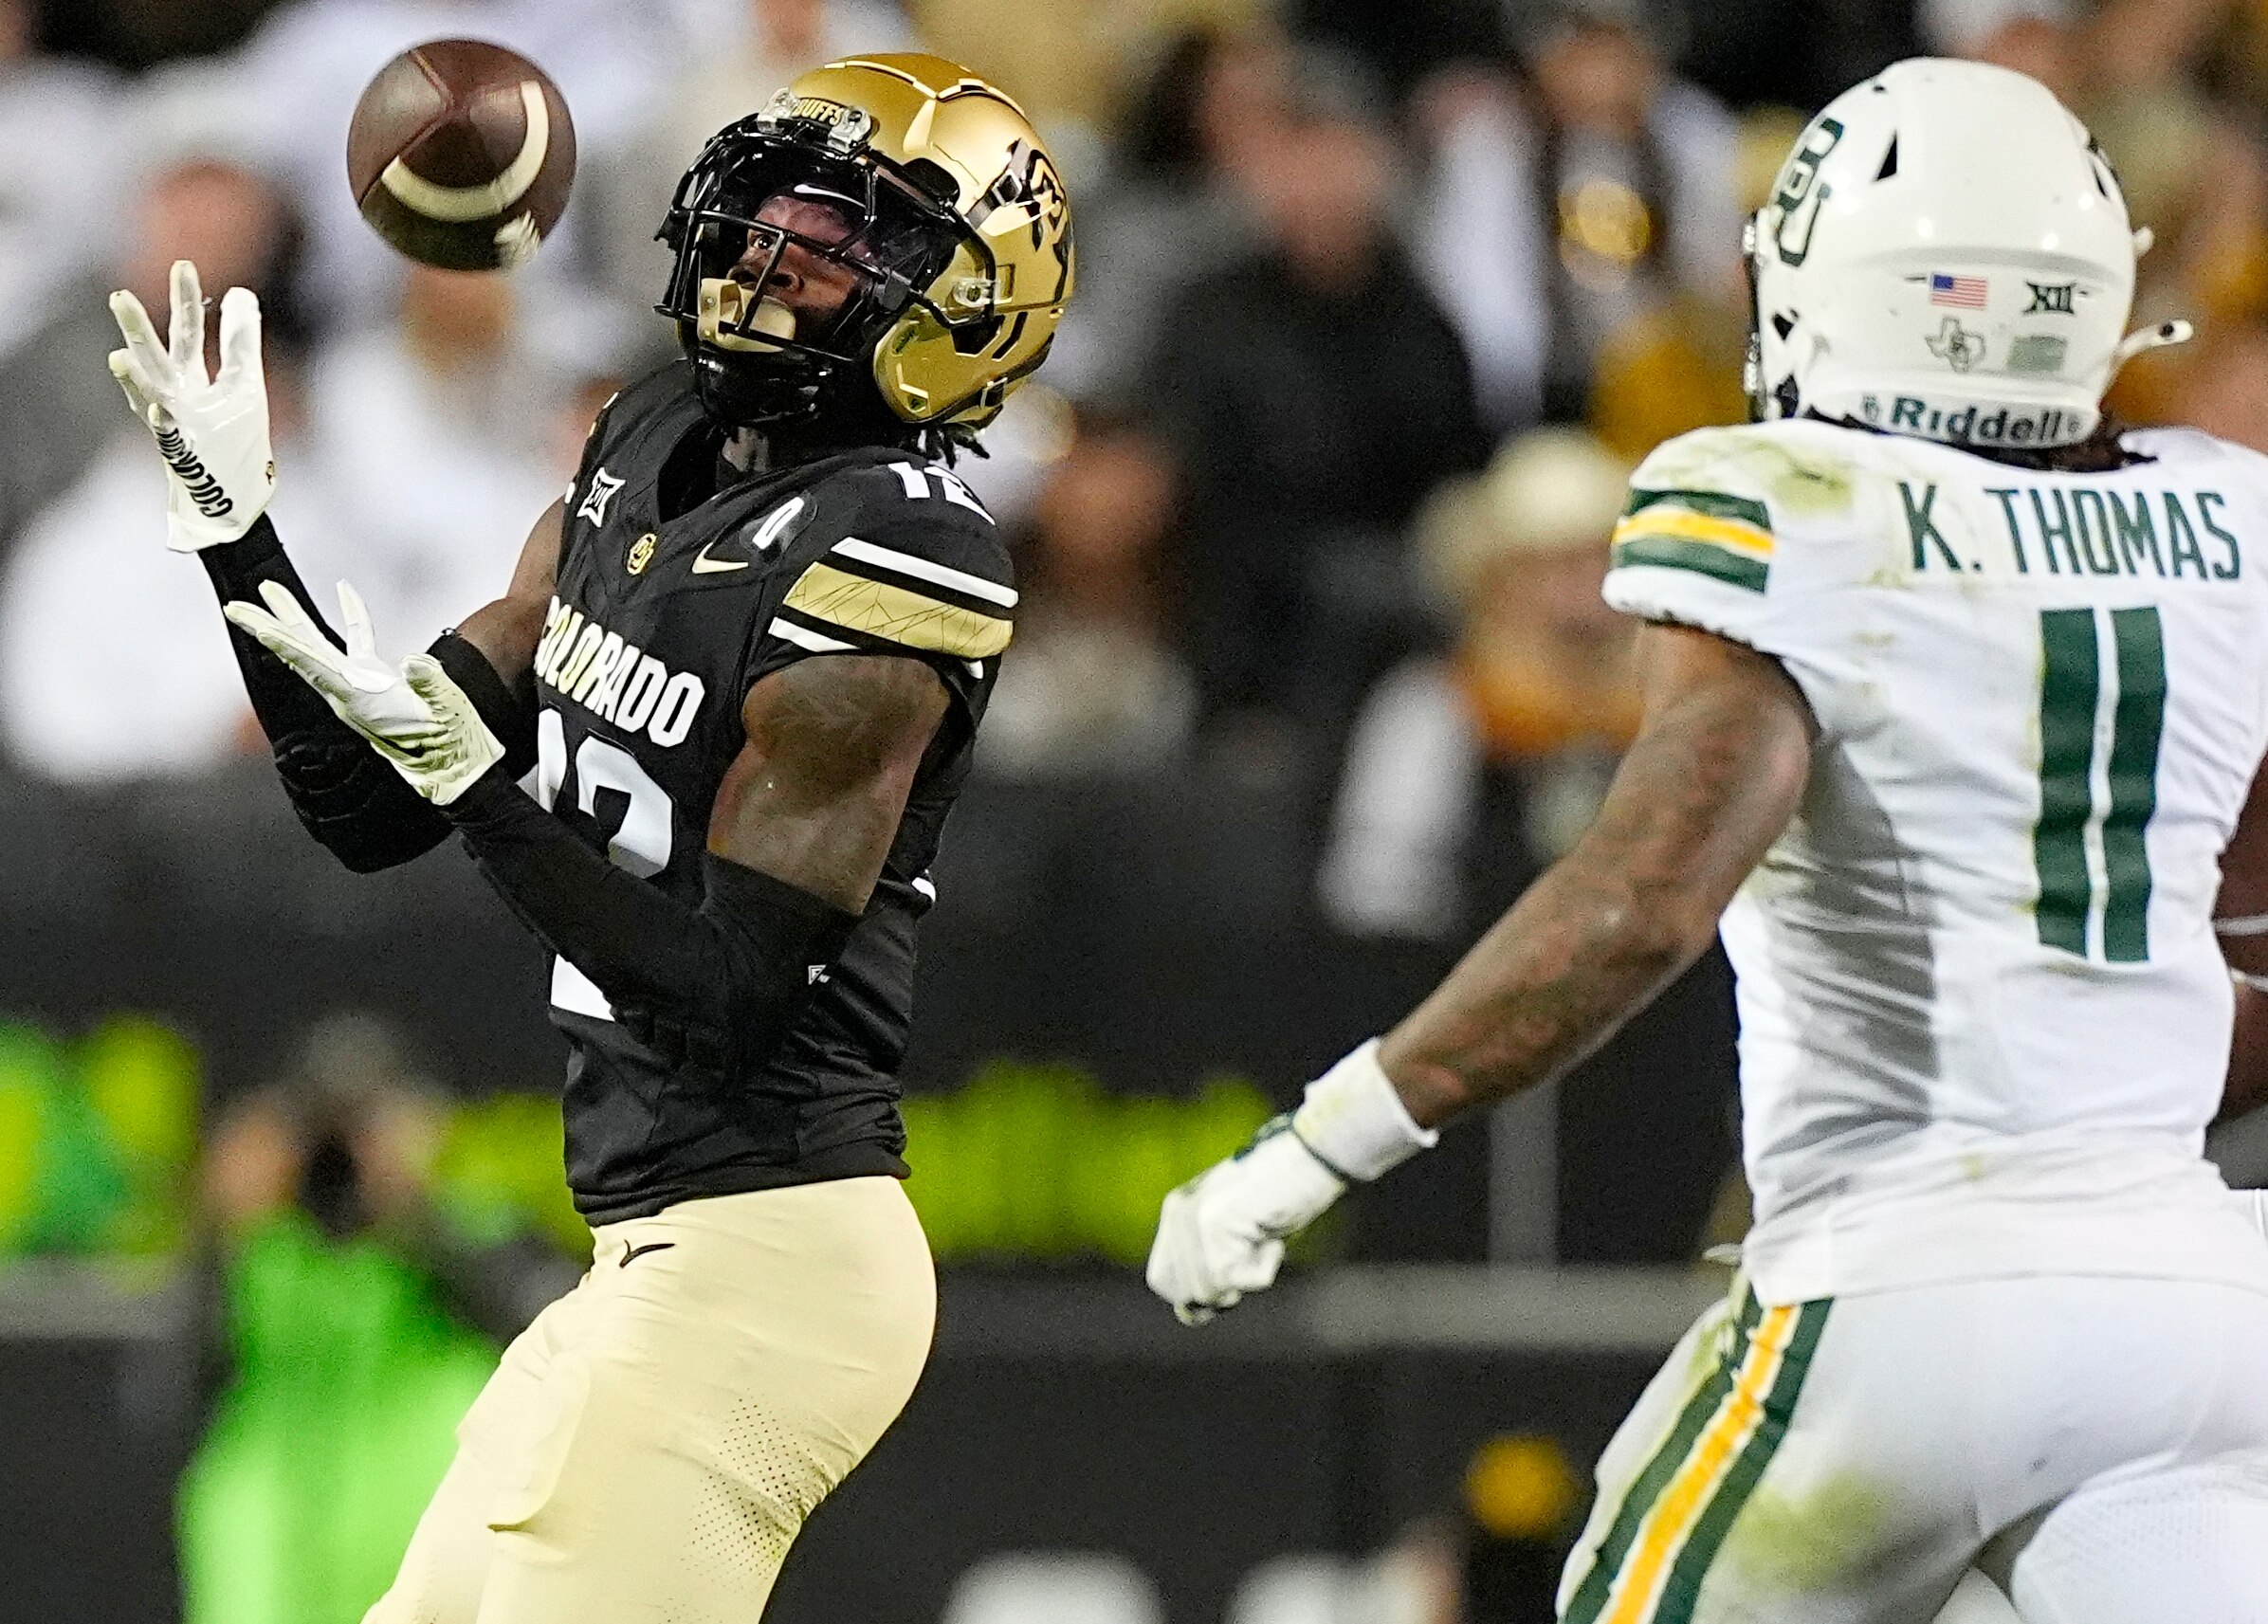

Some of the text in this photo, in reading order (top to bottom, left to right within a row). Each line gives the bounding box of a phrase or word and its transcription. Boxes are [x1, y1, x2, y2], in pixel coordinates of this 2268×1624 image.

[1891, 394, 2062, 443] Riddell
[1897, 481, 2241, 581] K. THOMAS
[533, 594, 706, 748] COLORADO
[2035, 604, 2167, 963] 11
